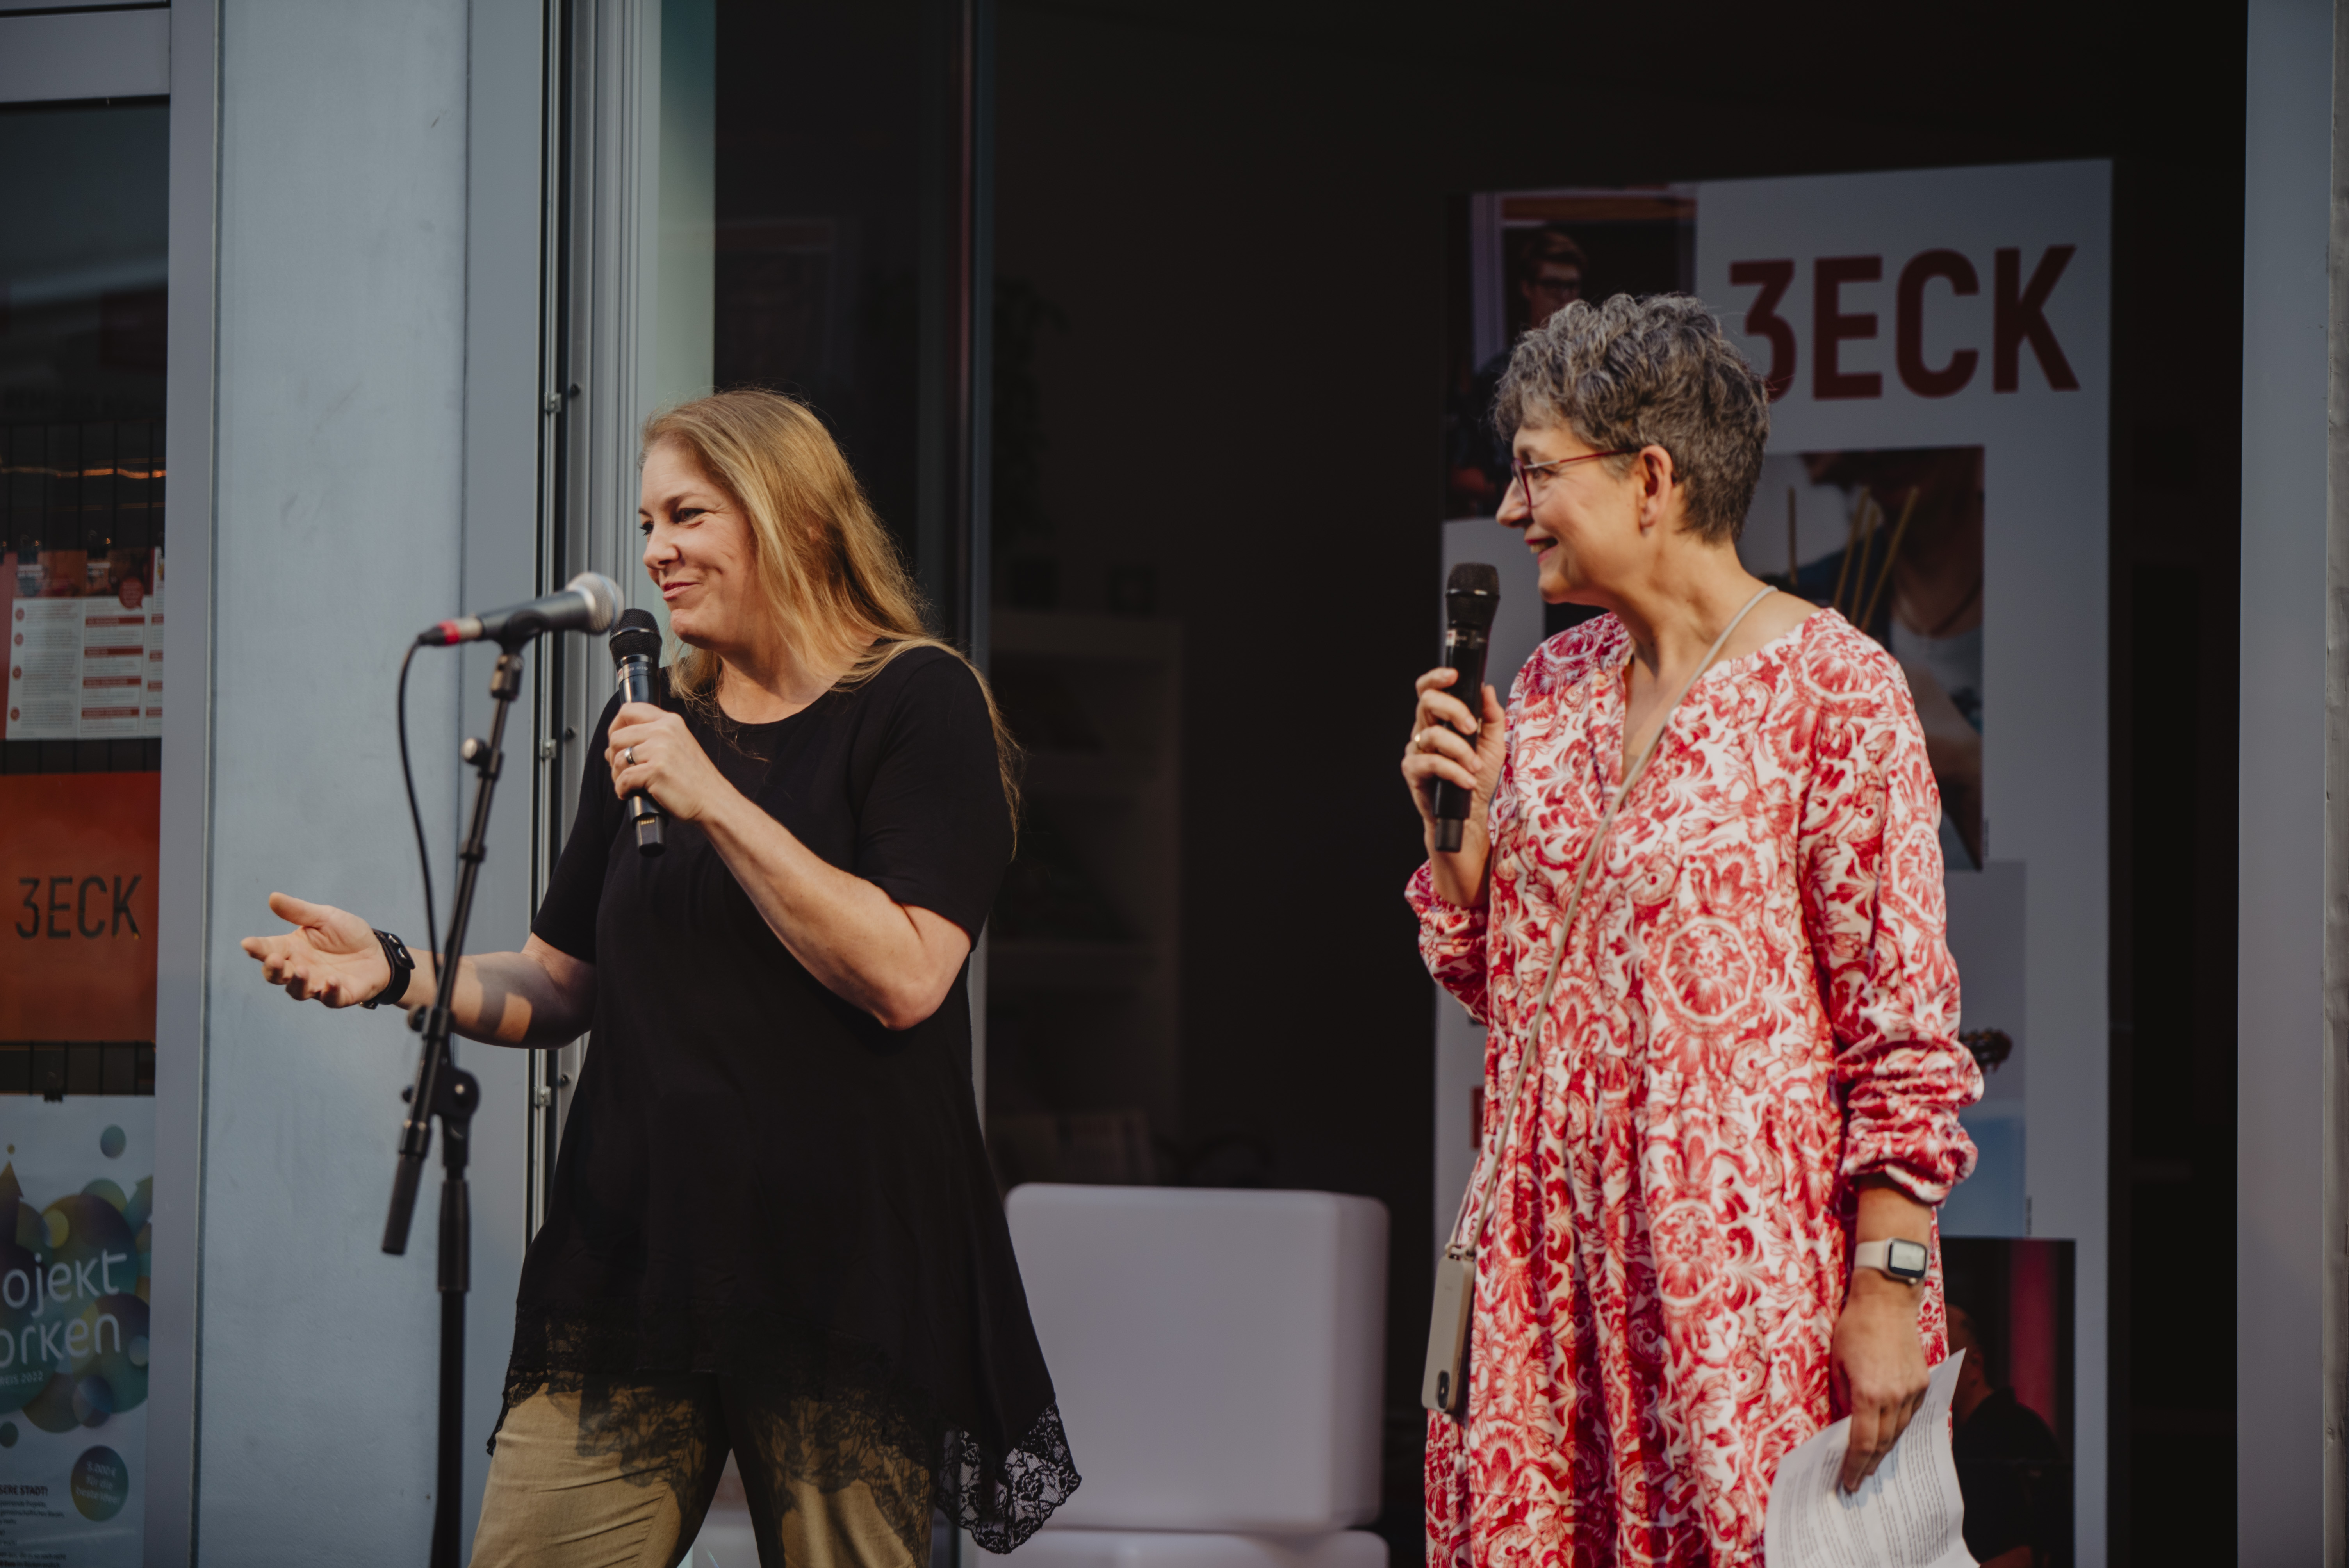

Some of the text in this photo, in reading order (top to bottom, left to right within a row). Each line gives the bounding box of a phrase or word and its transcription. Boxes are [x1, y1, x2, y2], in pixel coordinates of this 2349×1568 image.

[1728, 243, 2081, 403] 3ECK
[15, 875, 142, 939] 3ECK
[20, 1370, 43, 1384] 2022
[20, 1484, 48, 1496] STADT!
